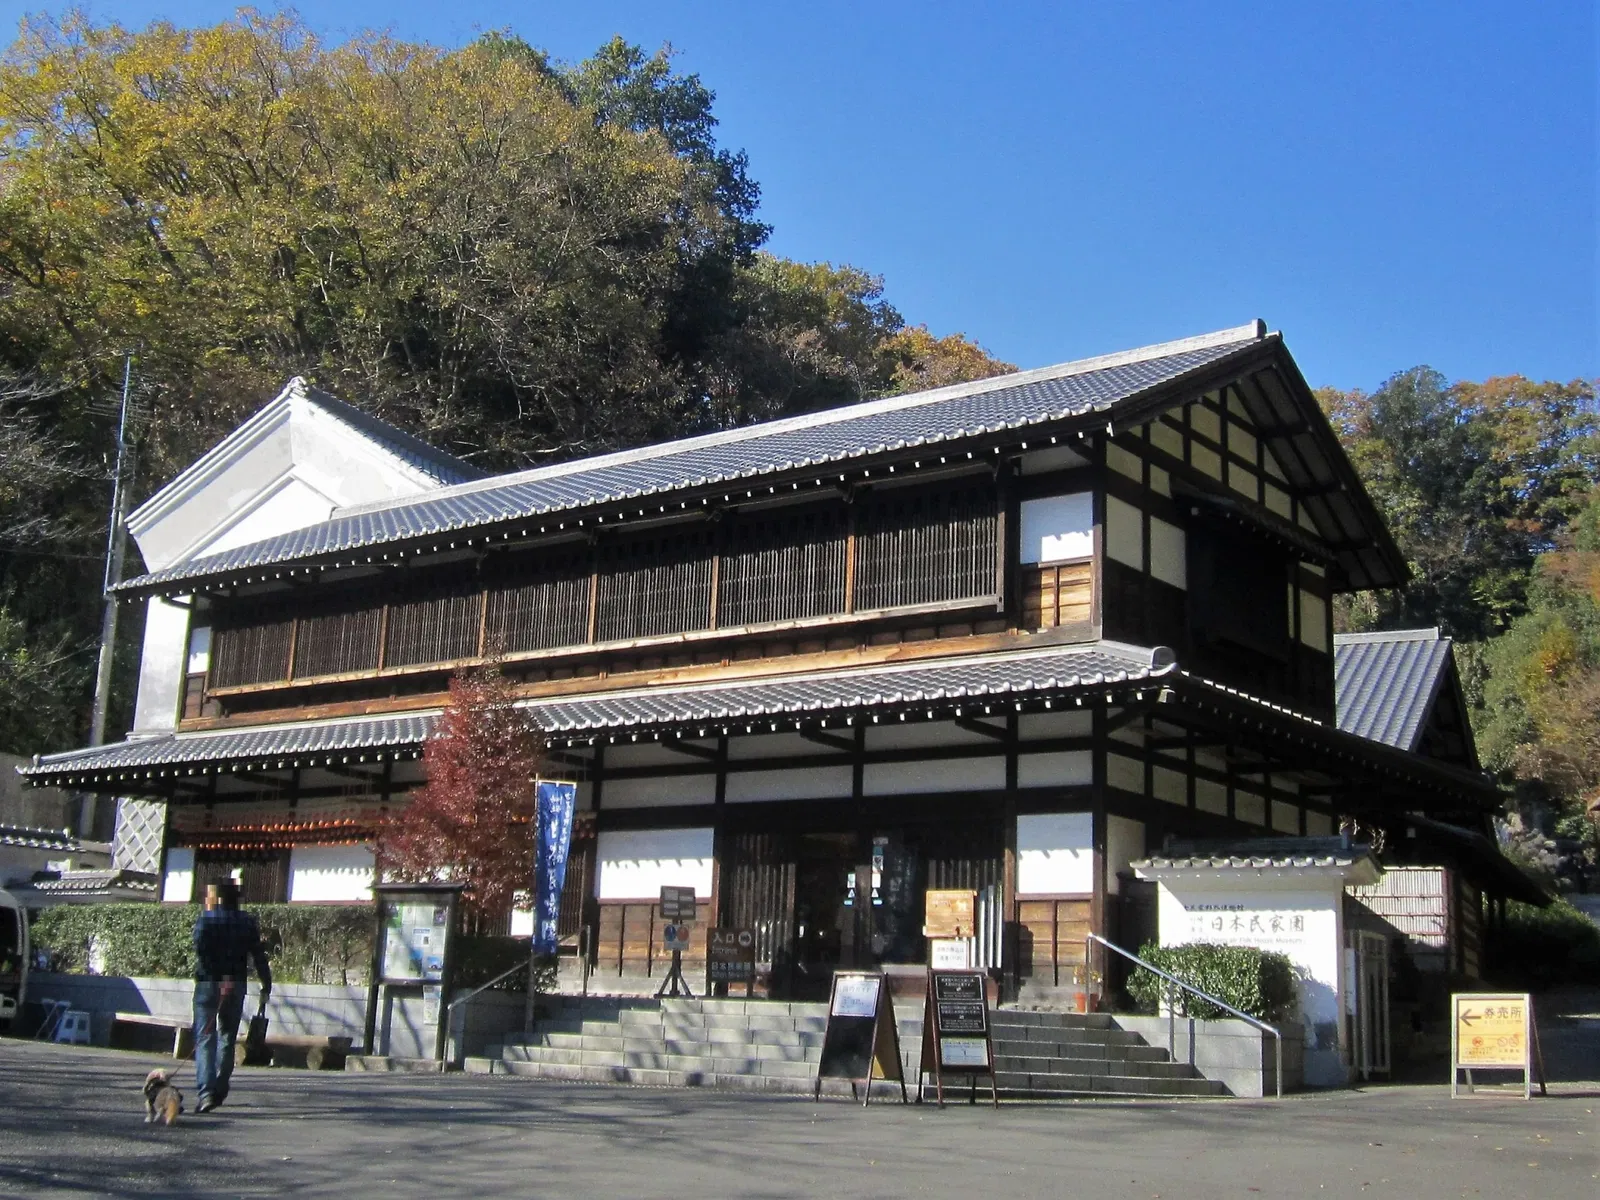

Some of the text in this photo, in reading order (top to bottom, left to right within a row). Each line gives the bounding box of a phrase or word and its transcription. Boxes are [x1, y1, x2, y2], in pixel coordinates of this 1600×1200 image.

[1211, 914, 1305, 933] 日本民家園
[712, 931, 735, 944] 入口
[1484, 1006, 1523, 1019] 券売所
